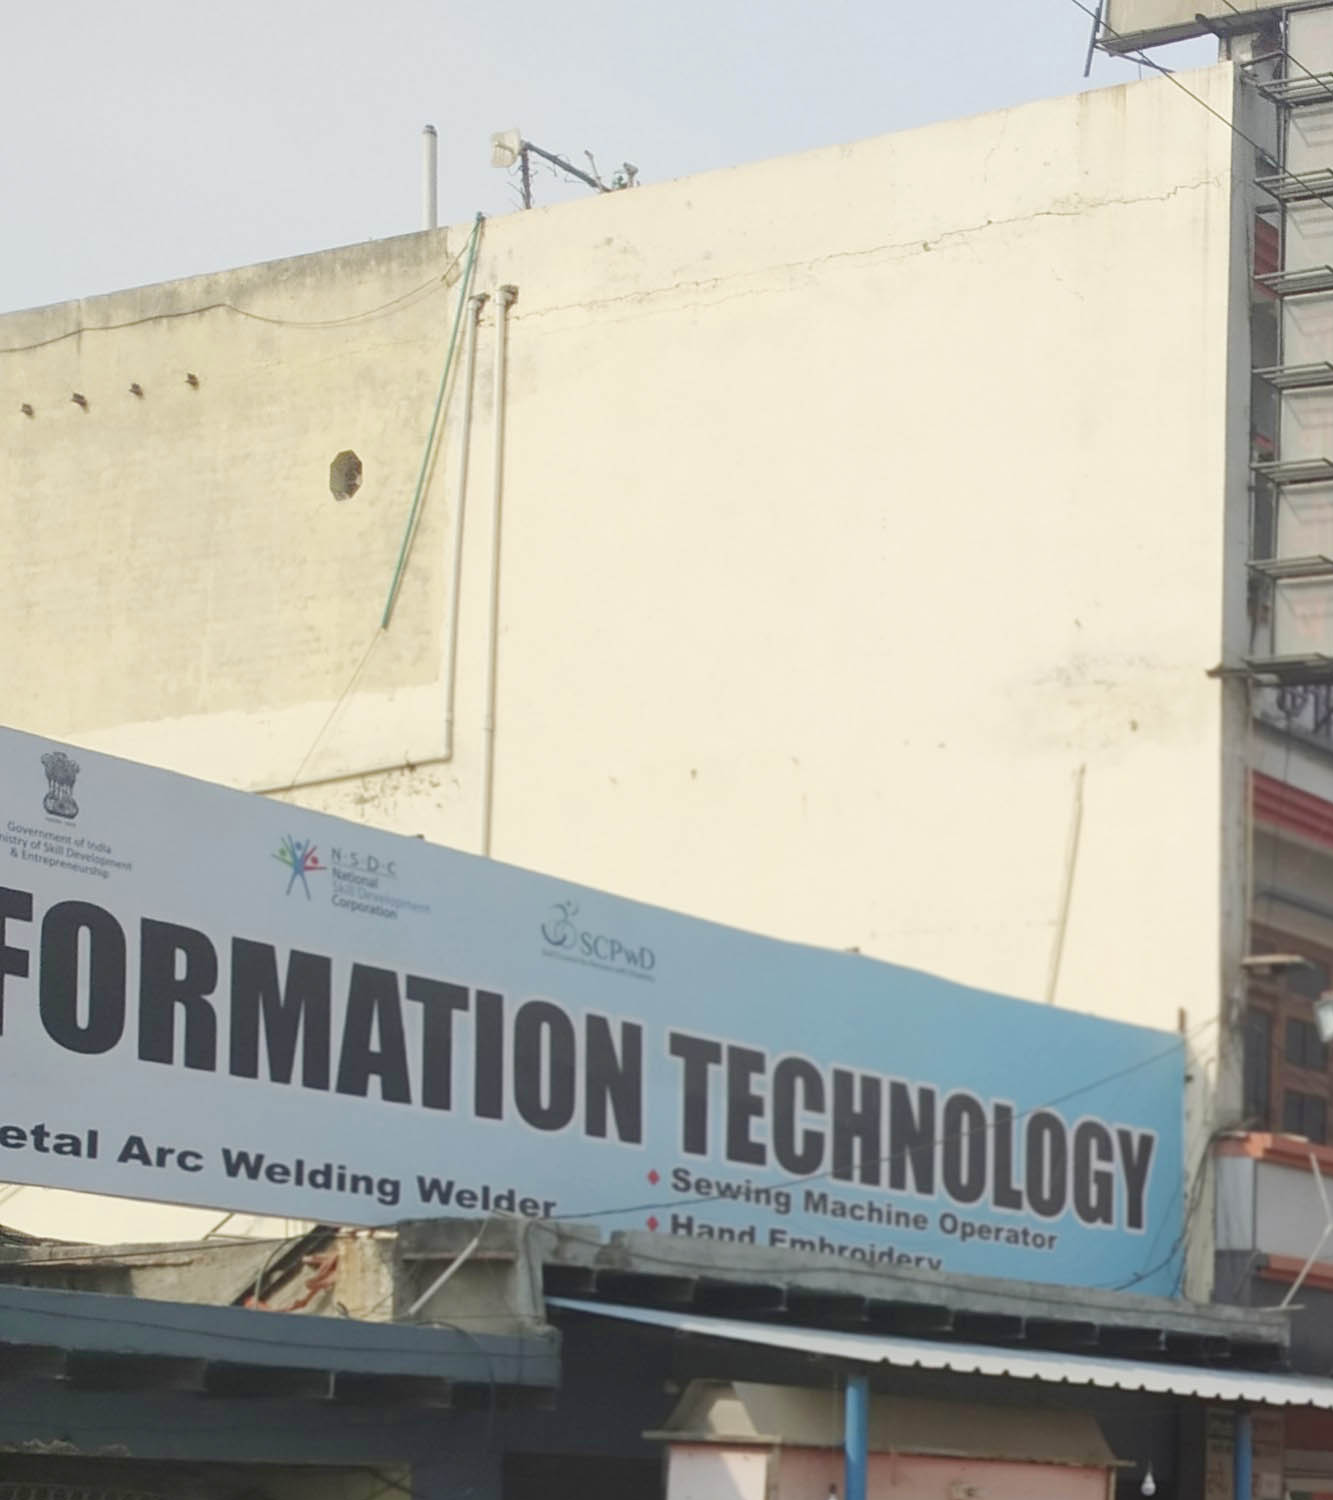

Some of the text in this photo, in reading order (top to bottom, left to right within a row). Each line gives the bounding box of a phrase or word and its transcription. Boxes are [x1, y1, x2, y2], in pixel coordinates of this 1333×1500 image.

[7, 821, 72, 844] Government
[10, 846, 110, 879] & Entrepreneurship
[43, 841, 64, 856] Skill
[66, 847, 132, 871] Development
[332, 865, 379, 888] National
[331, 893, 398, 919] Corporation
[579, 931, 656, 970] SCPwD
[669, 1031, 1155, 1231] TECHNOLOGY
[117, 1135, 204, 1172] Arc
[222, 1147, 401, 1206] Welding
[416, 1175, 557, 1219] Welder
[671, 1167, 1059, 1250] Sewing Machine Operator
[670, 1213, 943, 1271] Hand Embroidery
